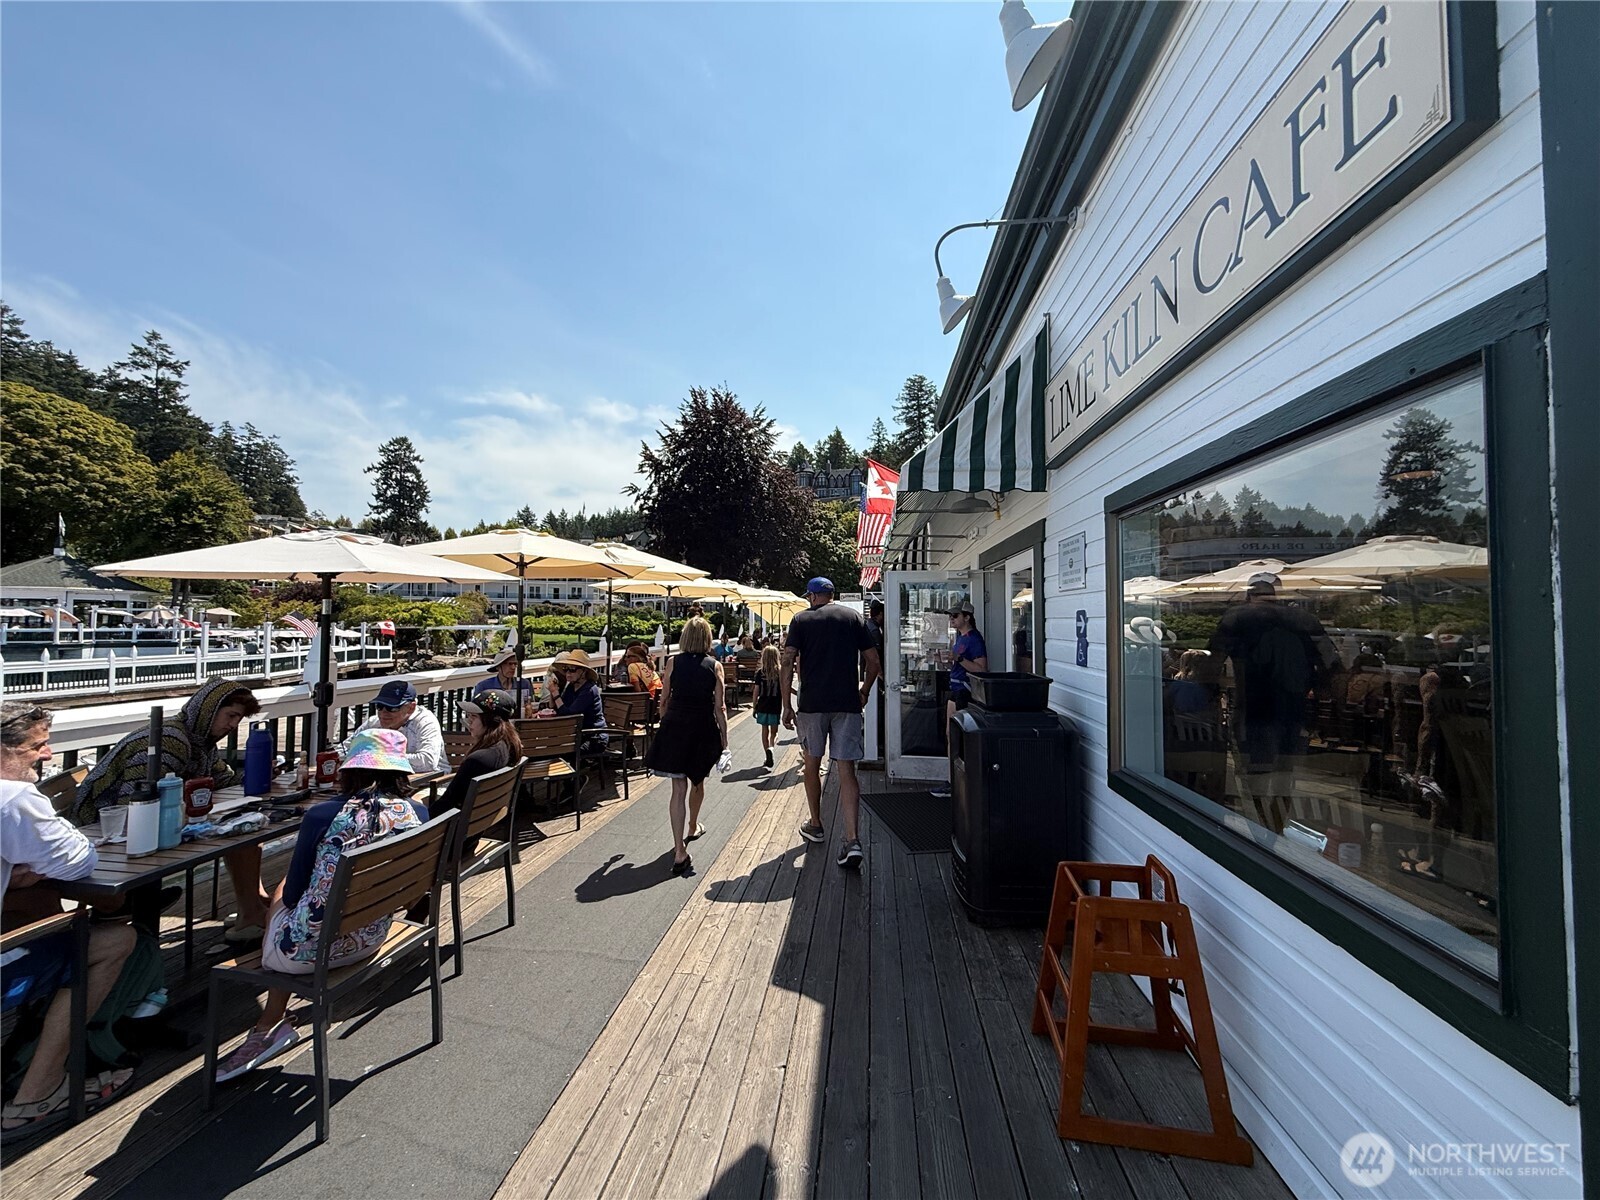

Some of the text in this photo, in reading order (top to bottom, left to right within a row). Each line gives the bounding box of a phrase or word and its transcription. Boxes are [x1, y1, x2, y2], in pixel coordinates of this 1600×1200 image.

[1049, 4, 1400, 443] LIME KILN CAFE
